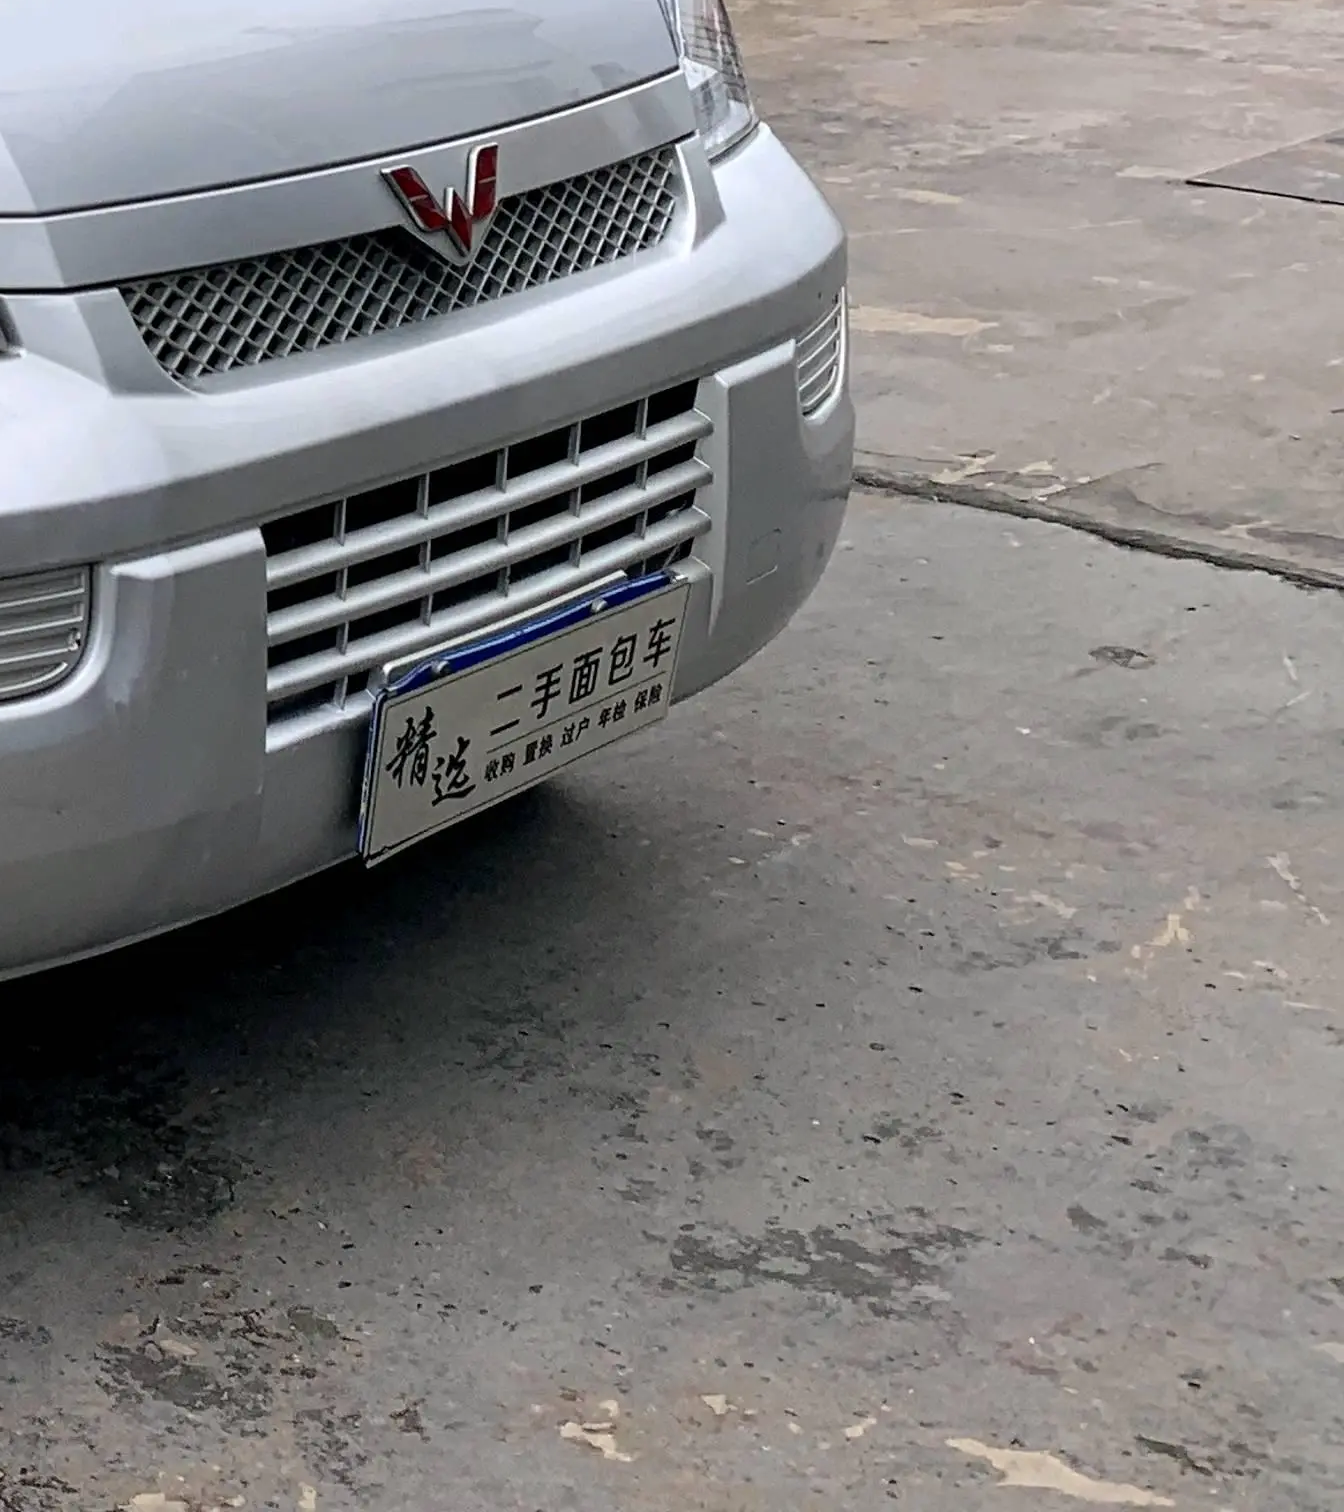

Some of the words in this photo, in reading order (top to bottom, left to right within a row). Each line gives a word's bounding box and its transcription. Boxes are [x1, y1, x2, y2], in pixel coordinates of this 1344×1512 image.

[490, 617, 677, 737] 二手面包车
[522, 733, 554, 766] 置换
[559, 716, 591, 749] 过户
[597, 699, 627, 730] 年检
[633, 682, 664, 714] 保险
[385, 705, 477, 807] 精选
